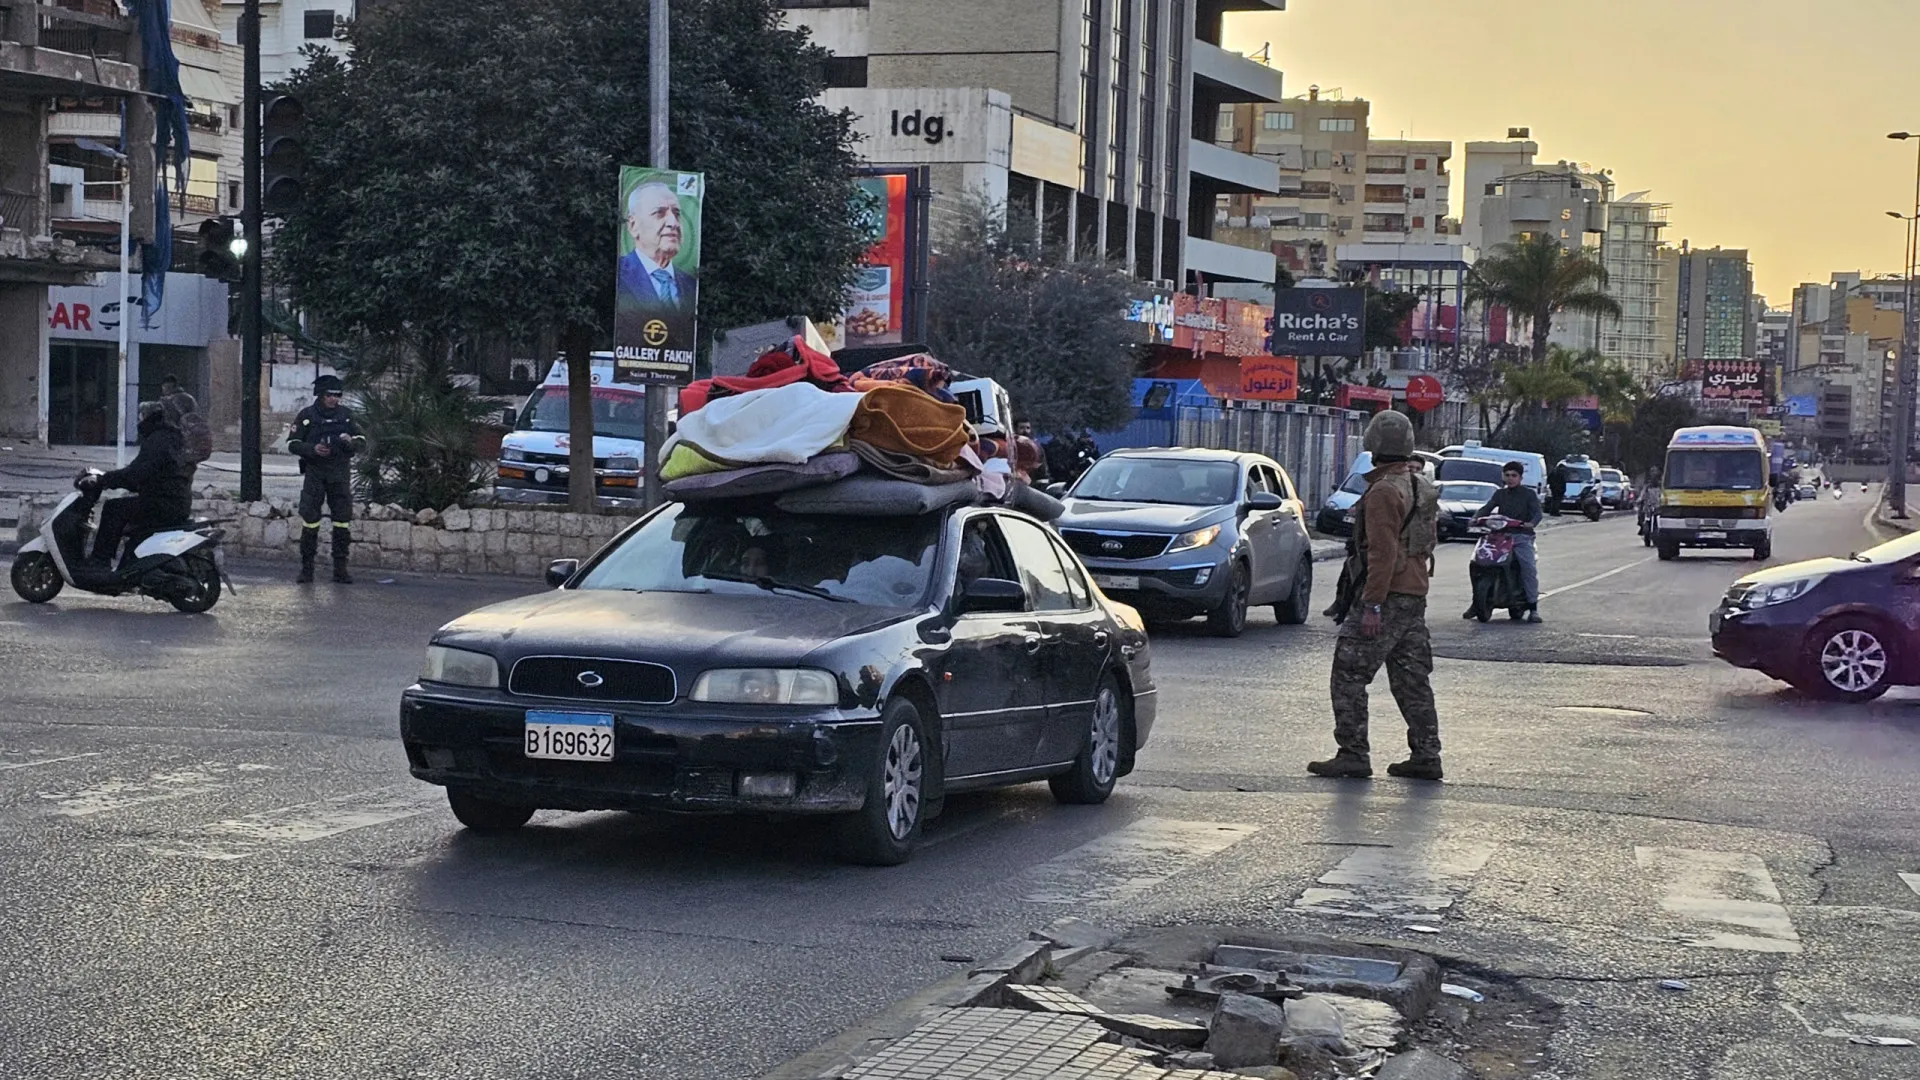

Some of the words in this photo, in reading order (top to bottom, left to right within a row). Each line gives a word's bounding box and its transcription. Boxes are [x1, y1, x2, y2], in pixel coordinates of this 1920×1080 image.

[48, 302, 92, 331] AR
[1288, 332, 1314, 341] Rent
[1317, 332, 1325, 341] A
[1329, 332, 1348, 341] Car
[616, 346, 660, 361] GALLERY
[664, 349, 693, 363] FAKIH
[629, 370, 647, 378] Saint
[1708, 372, 1758, 386] كاليري
[1243, 378, 1292, 394] الزغلول
[1104, 542, 1120, 550] KIA
[527, 729, 612, 757] B169632
